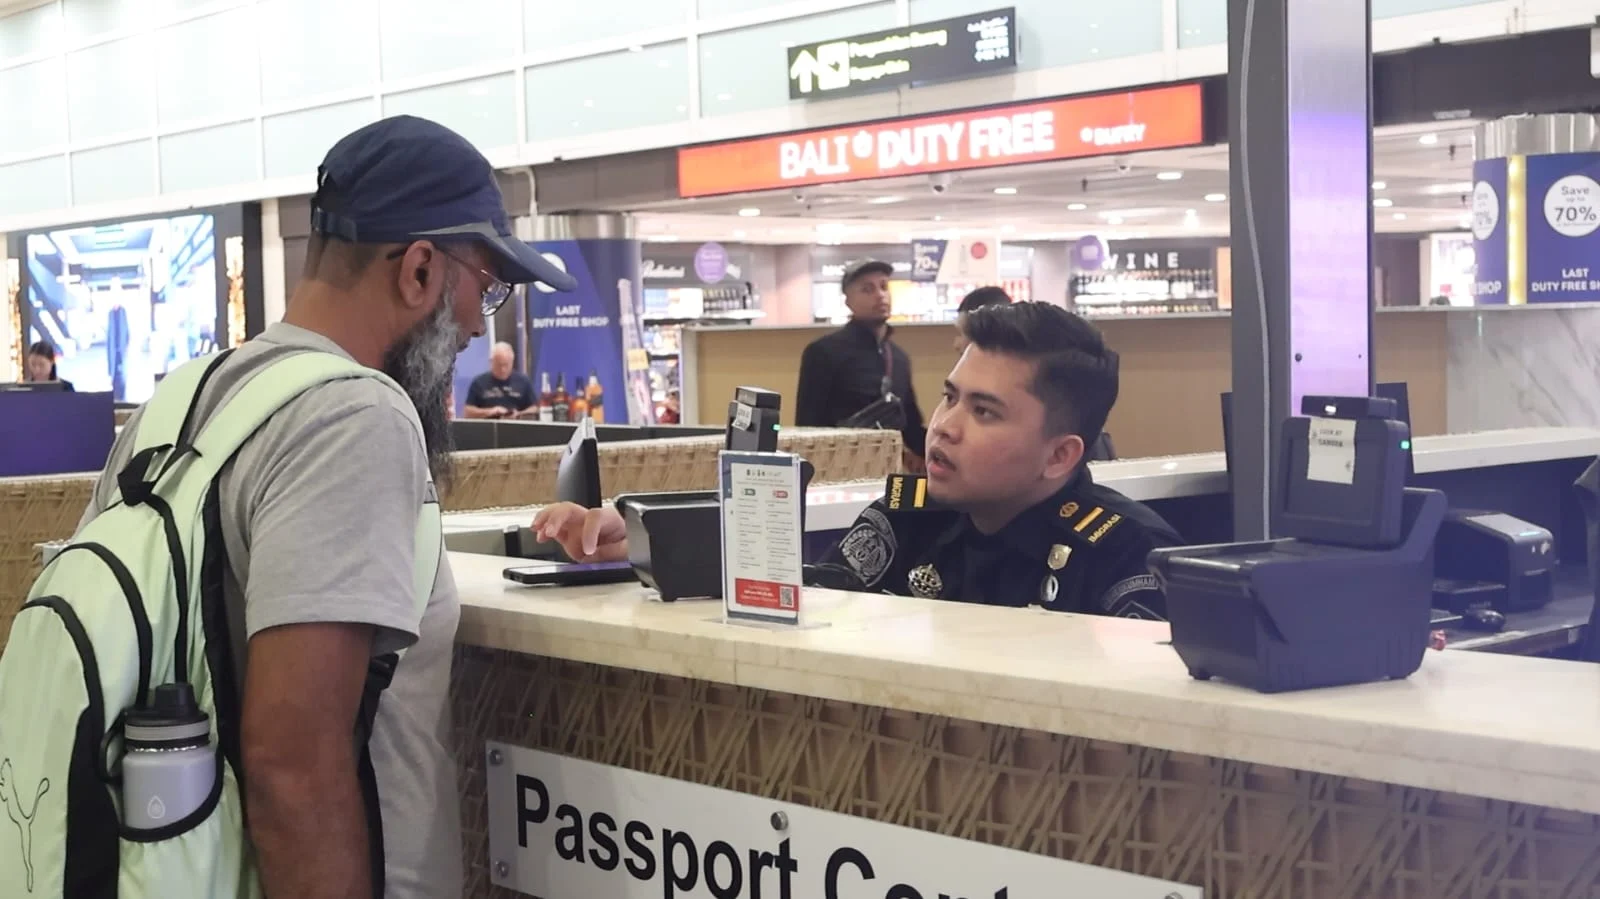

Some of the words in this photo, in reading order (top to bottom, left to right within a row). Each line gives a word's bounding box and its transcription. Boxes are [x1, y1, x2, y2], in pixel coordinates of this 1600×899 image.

[780, 135, 850, 178] BALI
[877, 122, 965, 169] DUTY
[969, 111, 1054, 159] FREE
[1561, 186, 1590, 195] Save
[1554, 206, 1597, 222] 70%
[1562, 268, 1589, 278] LAST
[1532, 281, 1559, 292] DUTY
[1561, 281, 1587, 291] FREE
[556, 305, 581, 316] LAST
[533, 318, 556, 328] DUTY
[557, 317, 579, 327] FREE
[581, 316, 609, 327] SHOP
[516, 774, 798, 899] Passport
